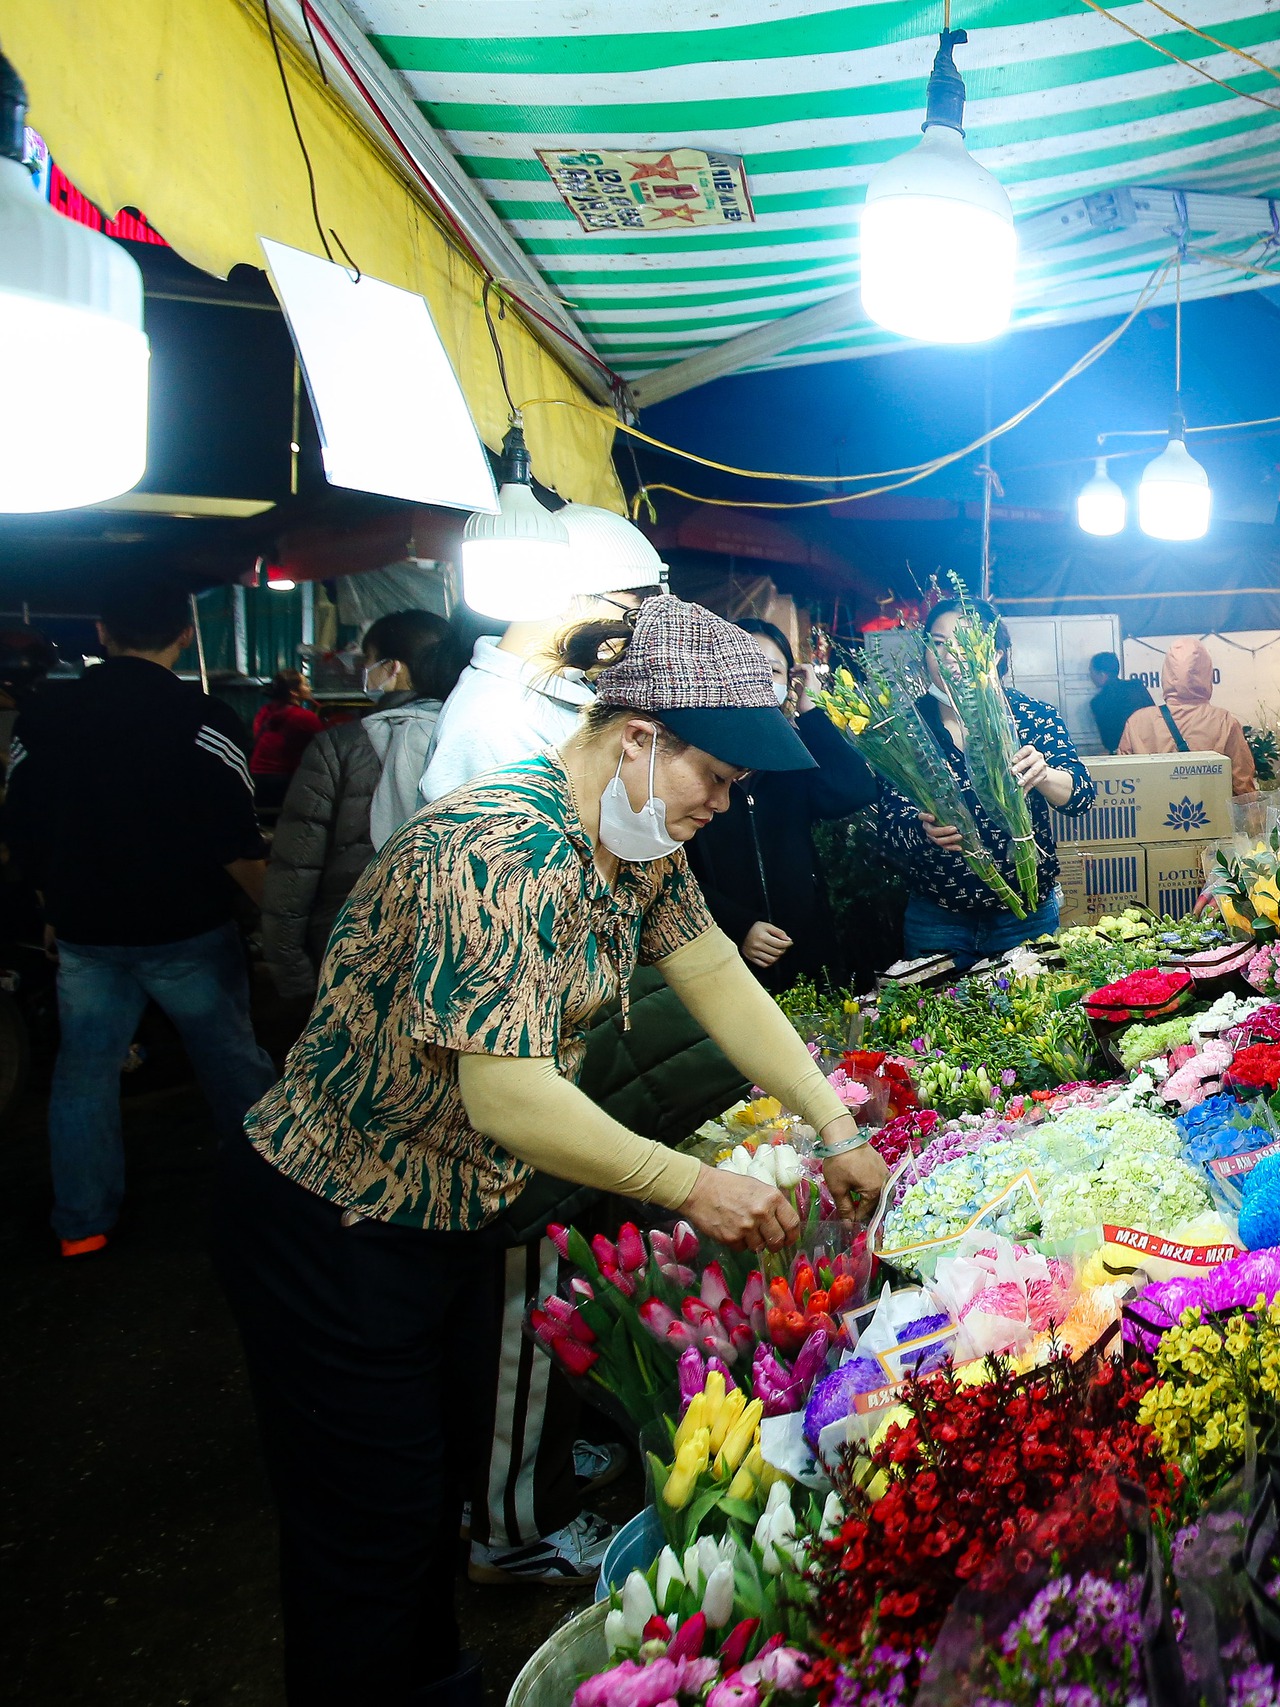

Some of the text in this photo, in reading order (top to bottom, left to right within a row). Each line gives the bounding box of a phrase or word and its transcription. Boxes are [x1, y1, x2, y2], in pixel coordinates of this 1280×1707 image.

[1173, 764, 1223, 775] ADVANTAGE
[1092, 778, 1136, 796] TUS
[1103, 798, 1136, 806] FOAM
[1159, 868, 1205, 882] LOTUS
[1158, 880, 1187, 888] FLORAL
